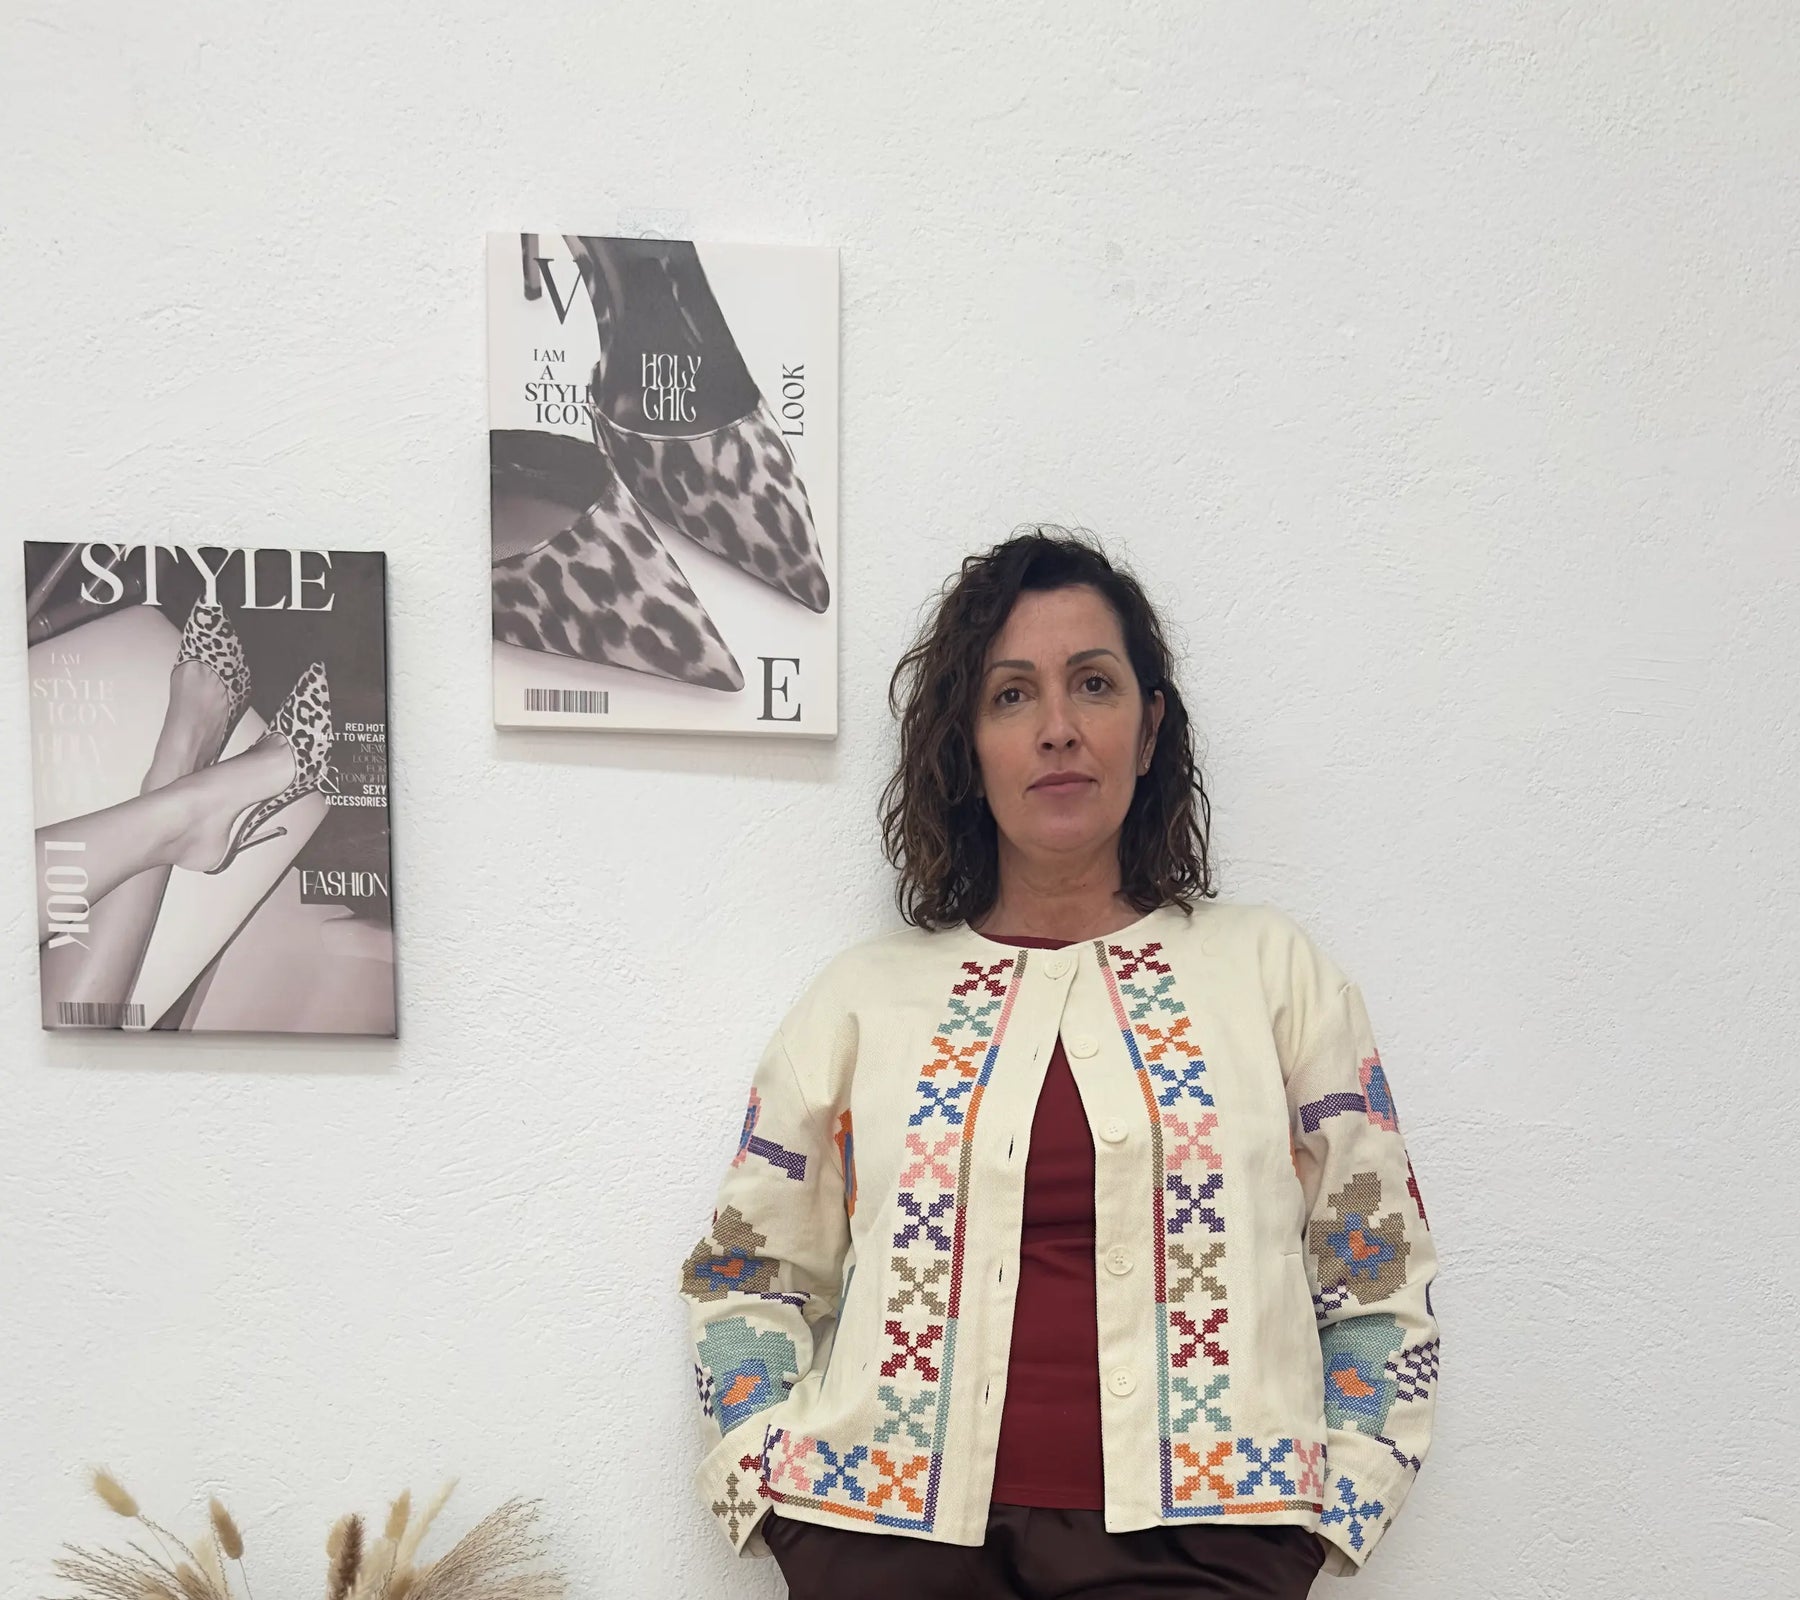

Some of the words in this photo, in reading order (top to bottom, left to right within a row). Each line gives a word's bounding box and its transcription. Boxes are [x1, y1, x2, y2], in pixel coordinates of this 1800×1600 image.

[533, 257, 584, 325] V
[533, 348, 538, 361] I
[541, 349, 565, 362] AM
[540, 364, 554, 380] A
[641, 353, 702, 391] HOLY
[642, 386, 697, 423] CHIC
[781, 363, 805, 437] LOOK
[81, 542, 335, 612] STYLE
[32, 677, 114, 701] STYLE
[756, 655, 803, 723] E
[316, 732, 341, 742] HAT
[343, 732, 355, 742] TO
[357, 733, 386, 743] WEAR
[345, 722, 365, 732] RED
[366, 723, 385, 732] HOT
[361, 743, 386, 753] NEW
[325, 795, 388, 807] ACCESSORIES
[362, 784, 387, 795] SEXY
[44, 841, 91, 950] LOOK
[302, 870, 388, 897] FASHION
